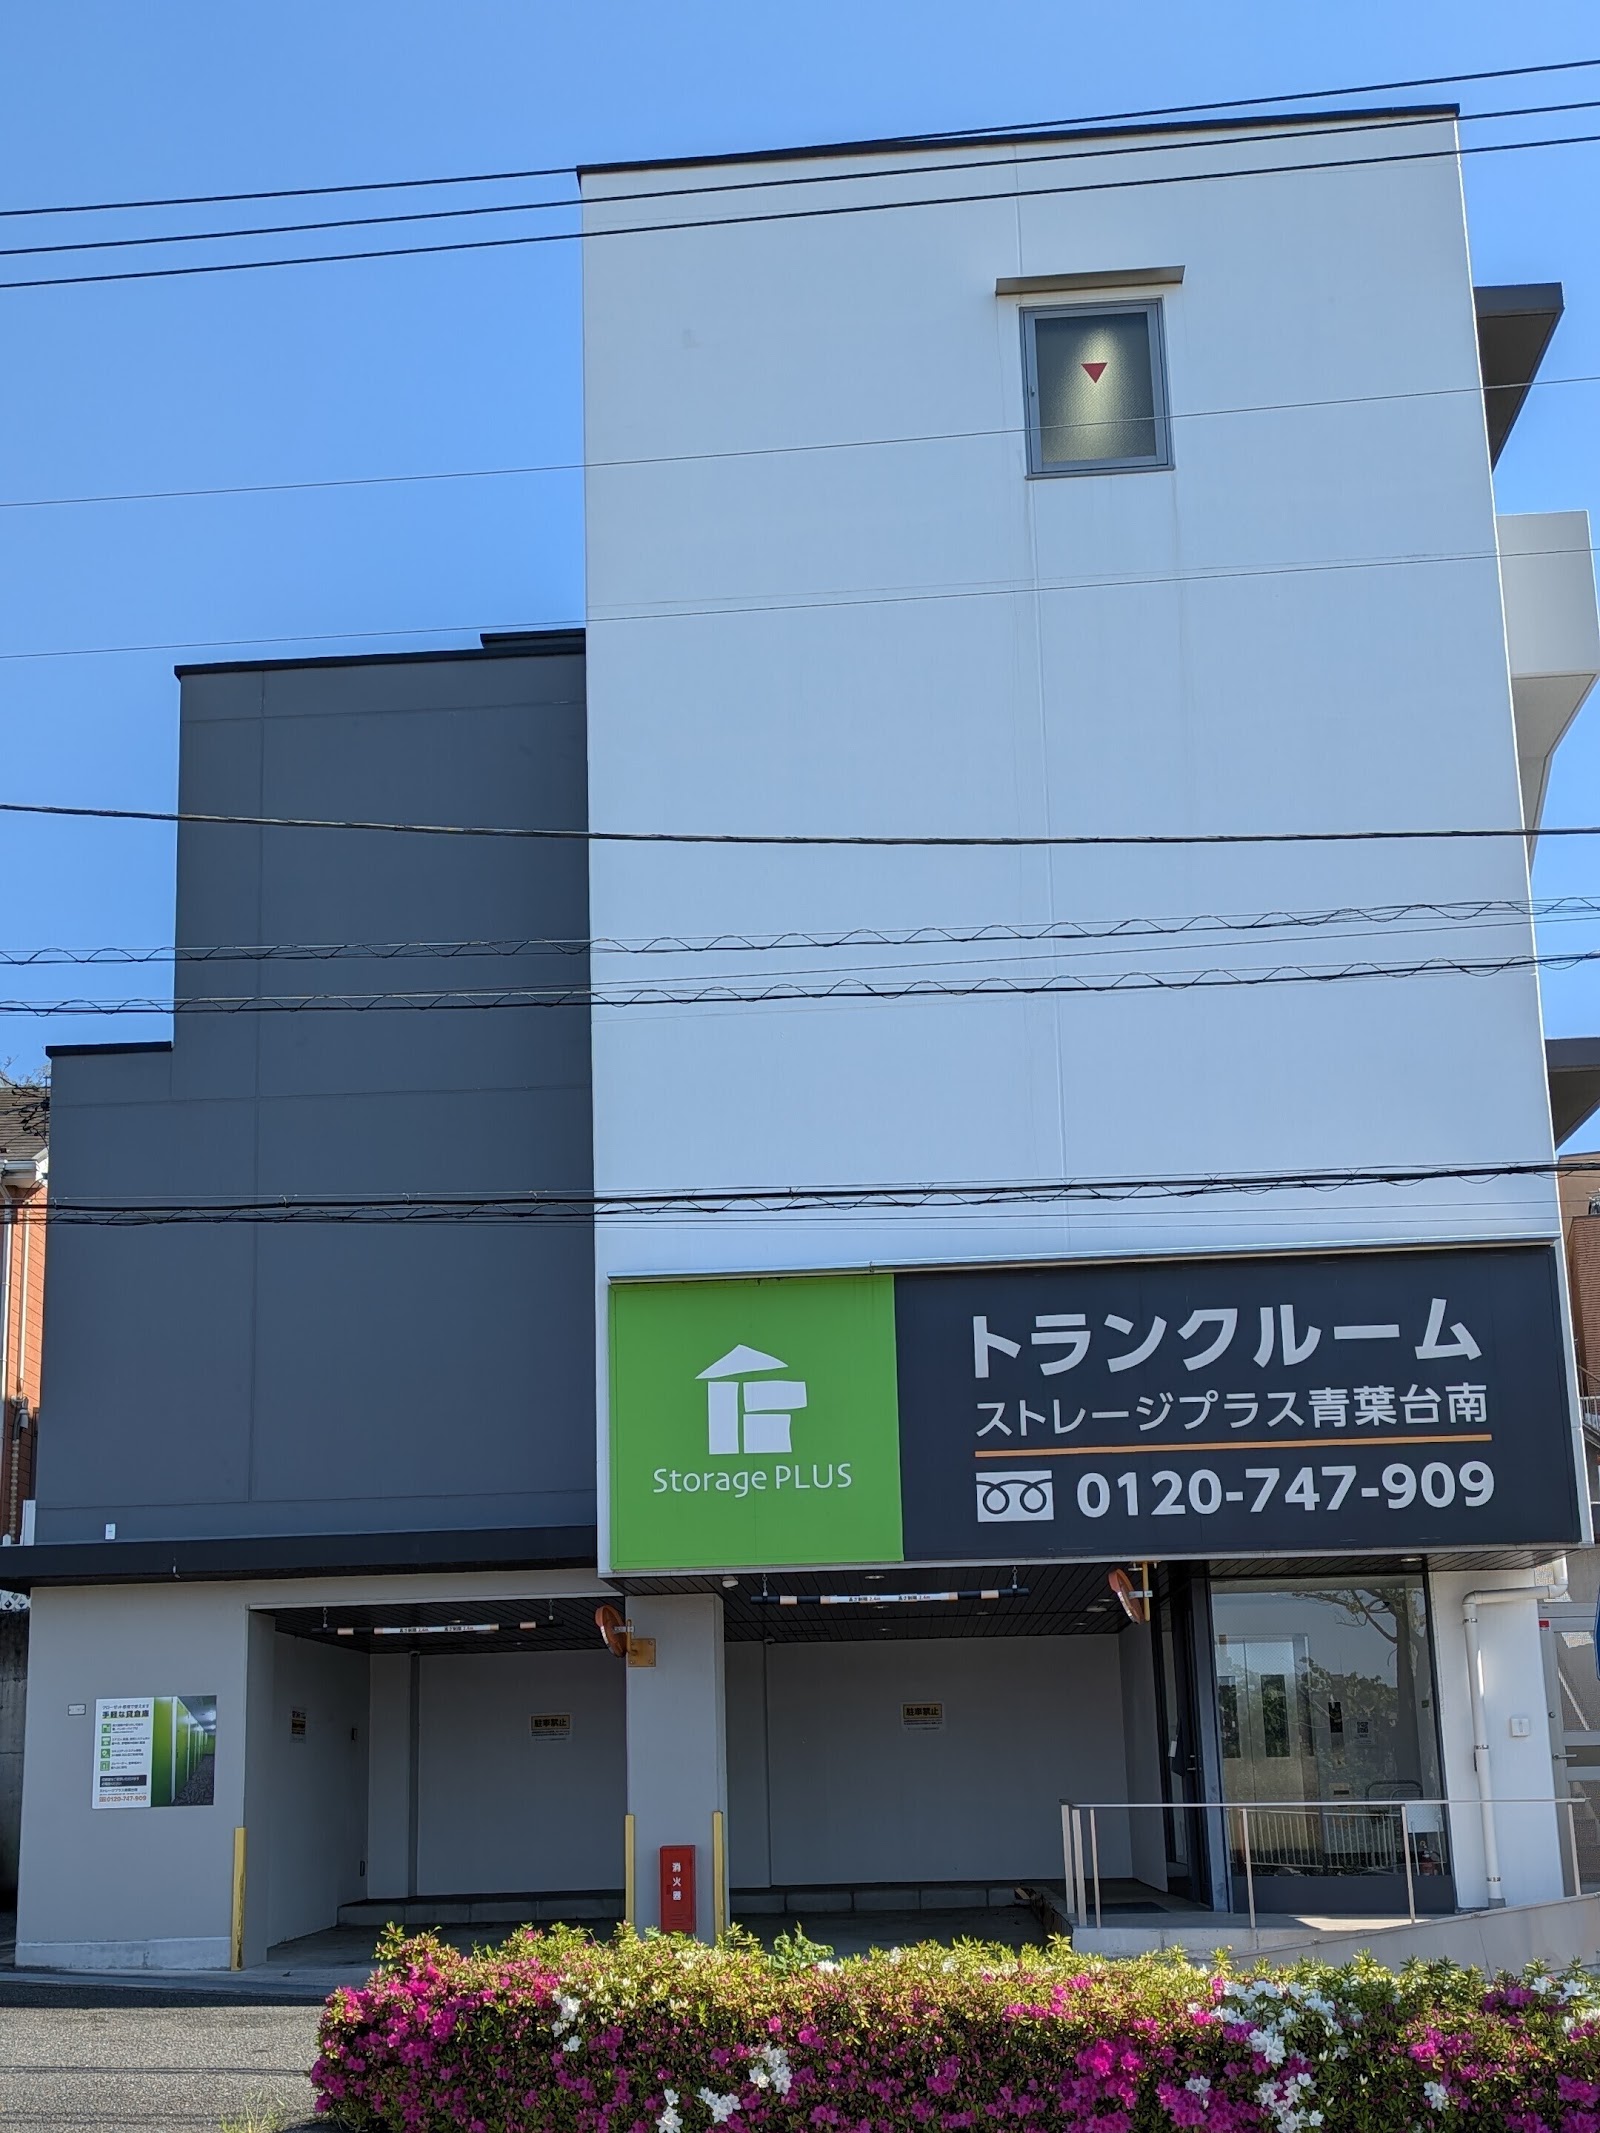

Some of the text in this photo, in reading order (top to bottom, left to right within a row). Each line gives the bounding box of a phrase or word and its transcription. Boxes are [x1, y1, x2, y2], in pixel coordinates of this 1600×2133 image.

[973, 1298, 1482, 1378] トランクルーム
[976, 1382, 1487, 1437] ストレージプラス青葉台南
[653, 1463, 852, 1498] Storage PLUS
[1076, 1460, 1495, 1518] 0120-747-909
[534, 1718, 567, 1728] 駐車禁止
[906, 1707, 939, 1716] 駐車禁止
[672, 1862, 682, 1901] 消火器
